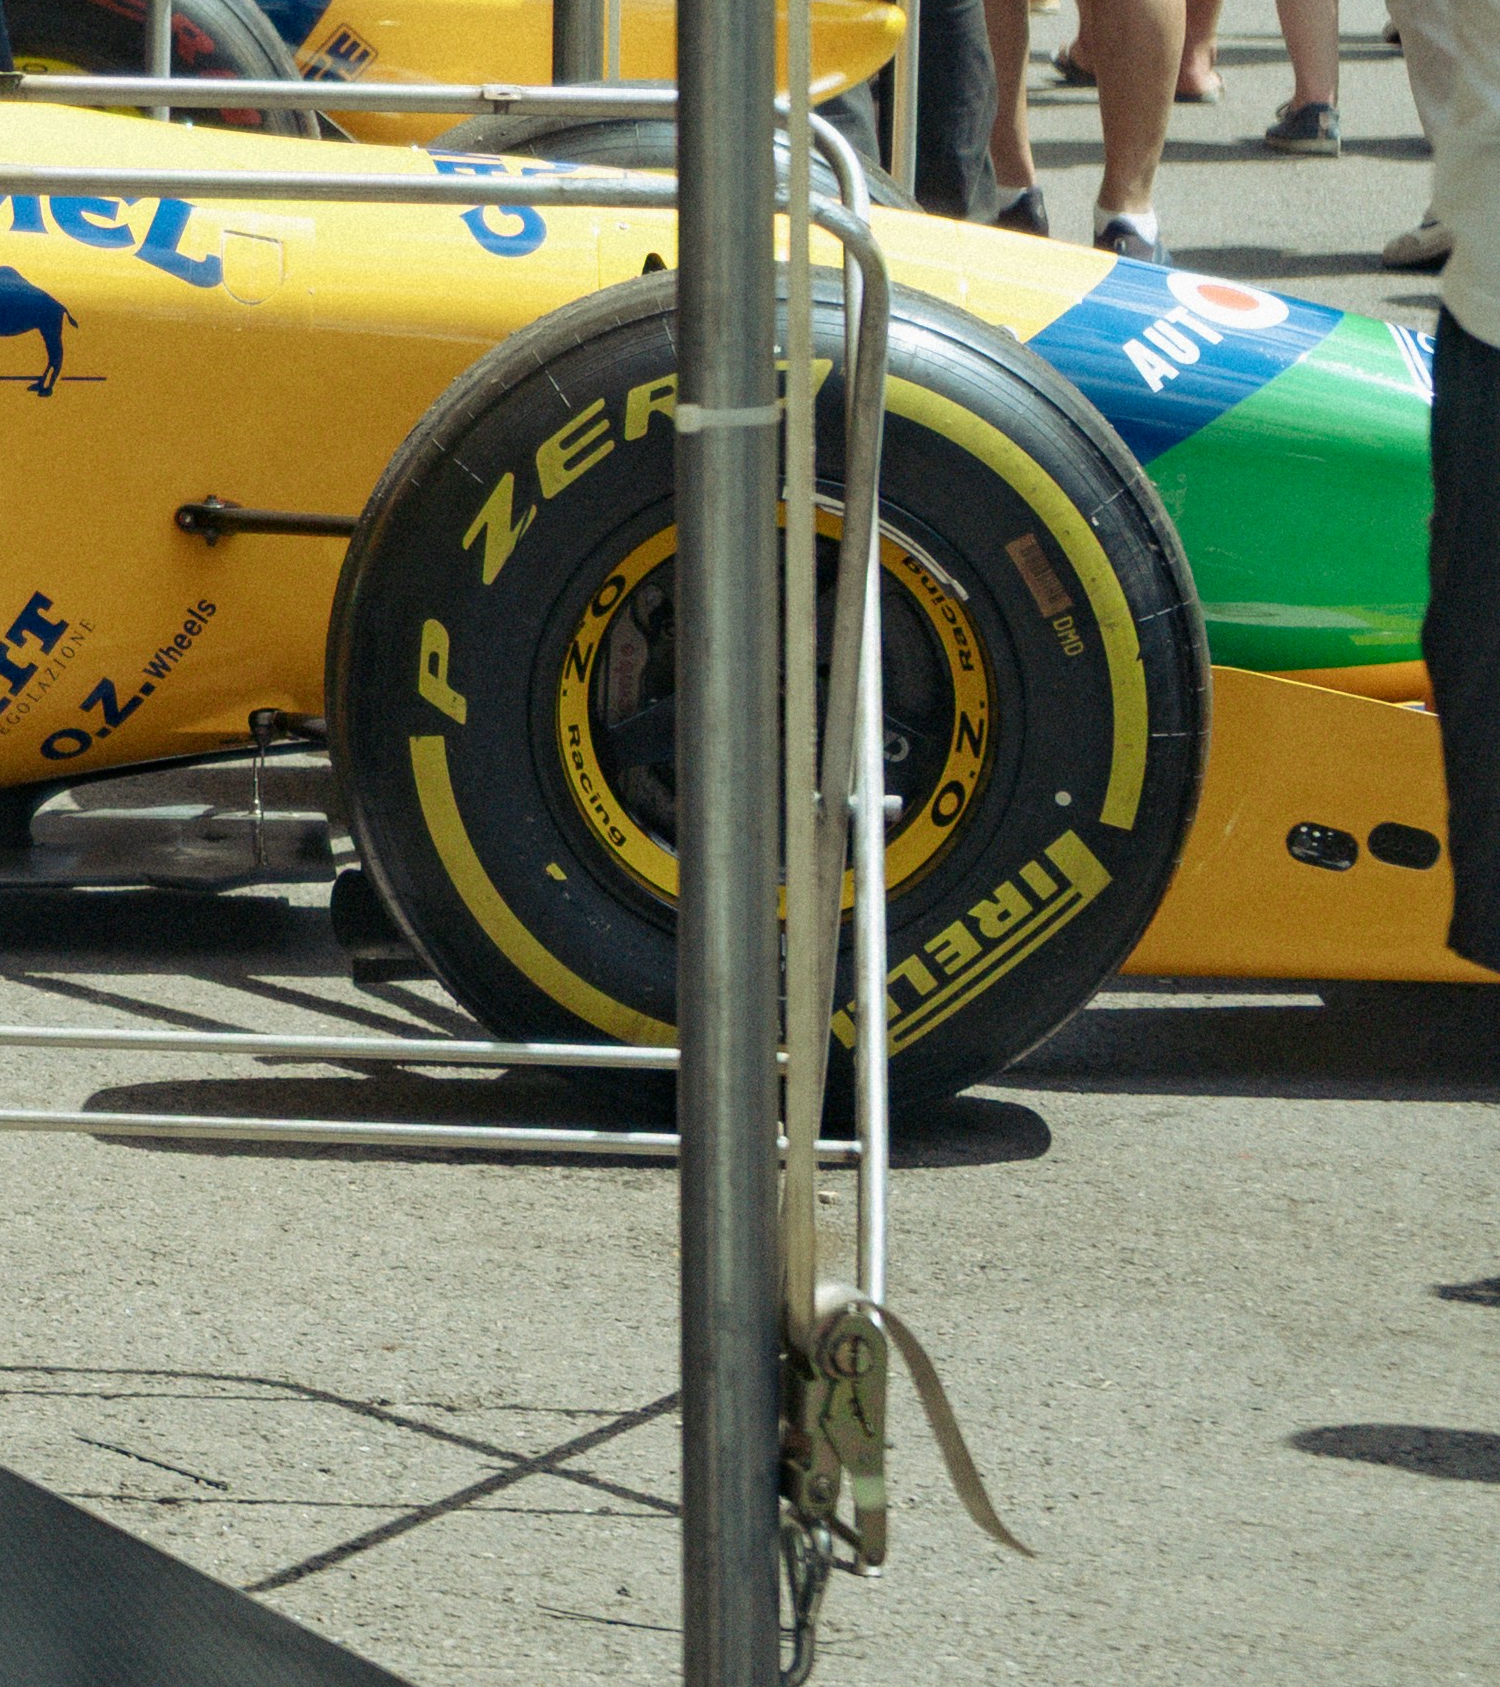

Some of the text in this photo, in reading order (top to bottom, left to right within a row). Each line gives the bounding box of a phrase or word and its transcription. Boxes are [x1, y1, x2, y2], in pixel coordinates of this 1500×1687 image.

[1121, 271, 1290, 394] AUTO
[420, 617, 469, 725] P
[461, 358, 834, 586] ZER
[143, 598, 218, 681] Wheels
[901, 554, 975, 673] Racing
[1052, 615, 1085, 657] DMD
[566, 723, 628, 850] Racing
[830, 828, 1113, 1061] PIRELI
